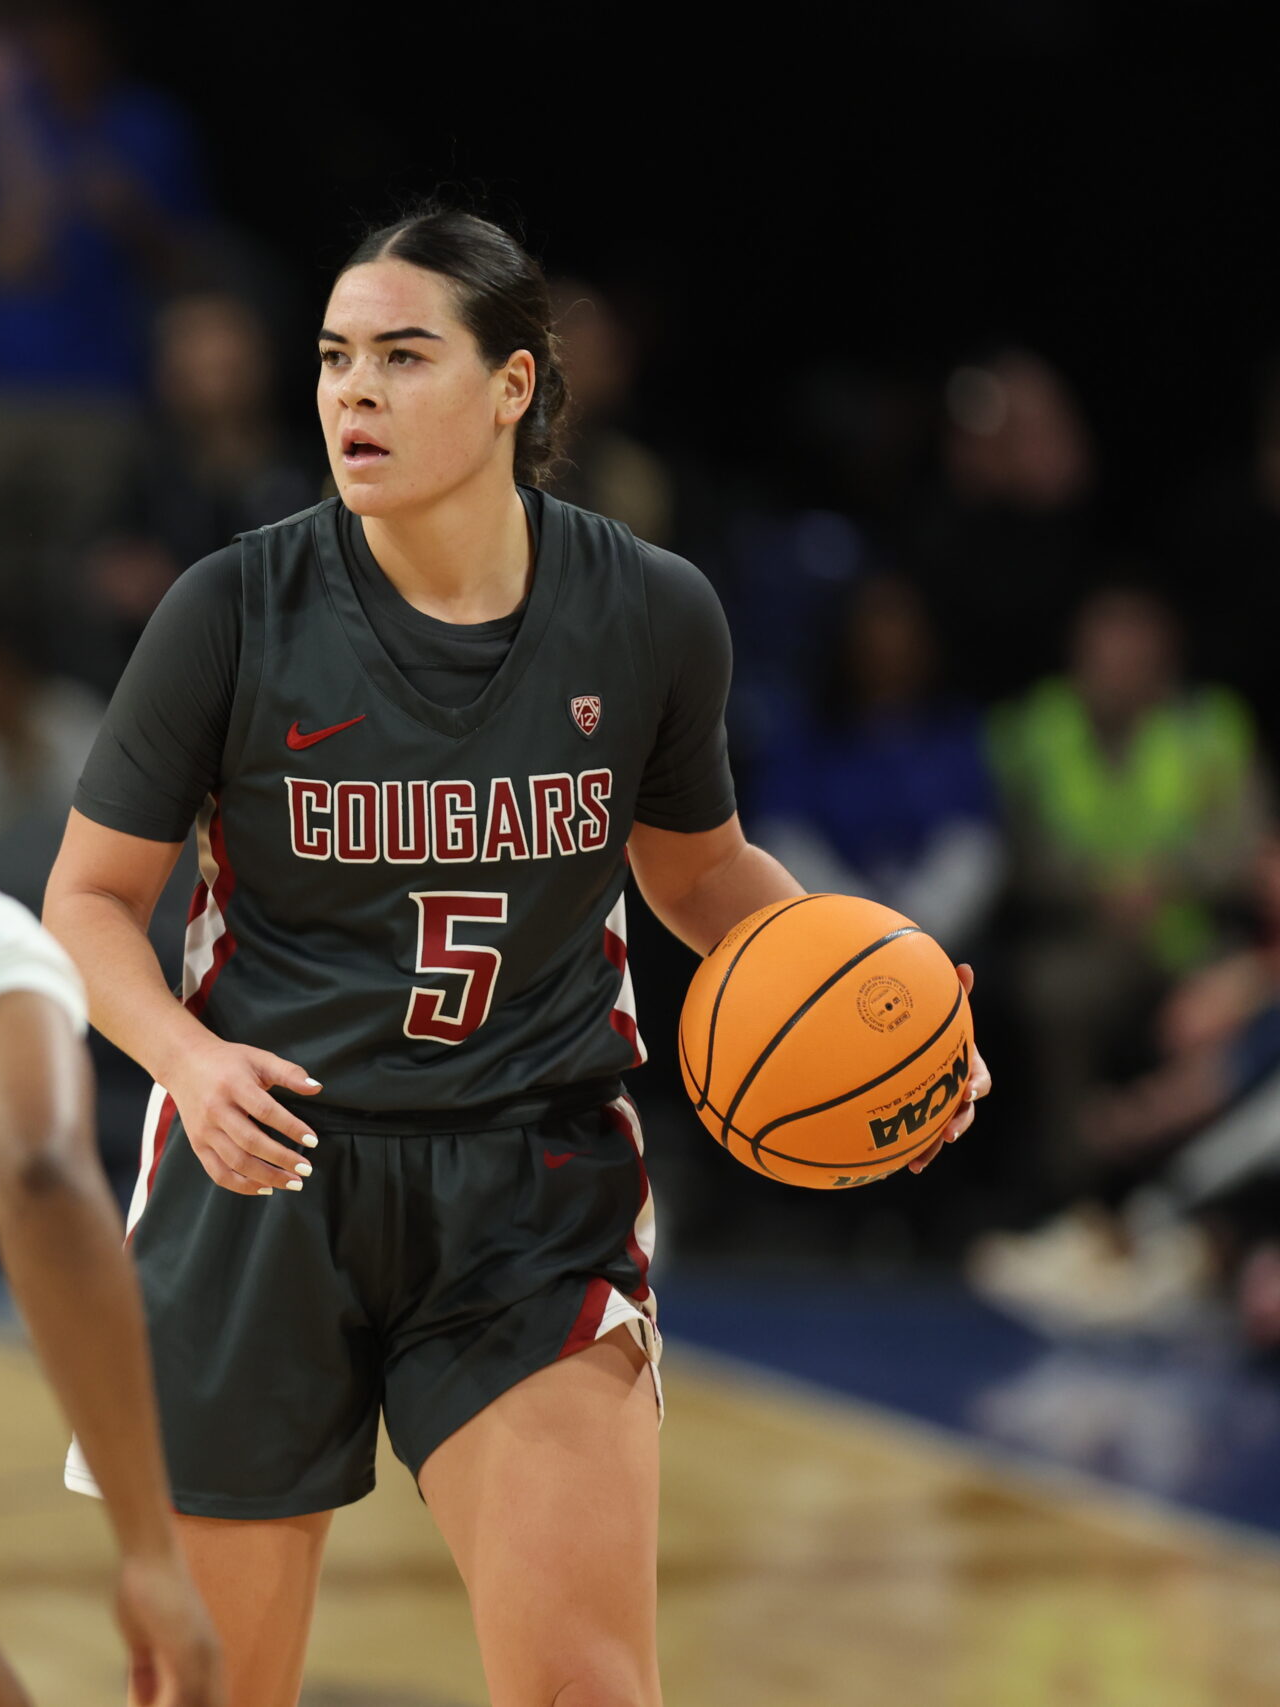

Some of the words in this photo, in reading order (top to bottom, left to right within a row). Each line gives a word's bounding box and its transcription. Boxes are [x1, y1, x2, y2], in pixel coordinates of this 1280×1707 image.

[573, 698, 600, 719] PAC
[580, 712, 595, 727] 12
[284, 768, 613, 864] COUGARS
[403, 891, 508, 1046] 5
[868, 1038, 969, 1150] NCAA
[904, 1073, 936, 1100] GAME
[867, 1097, 902, 1115] BALL
